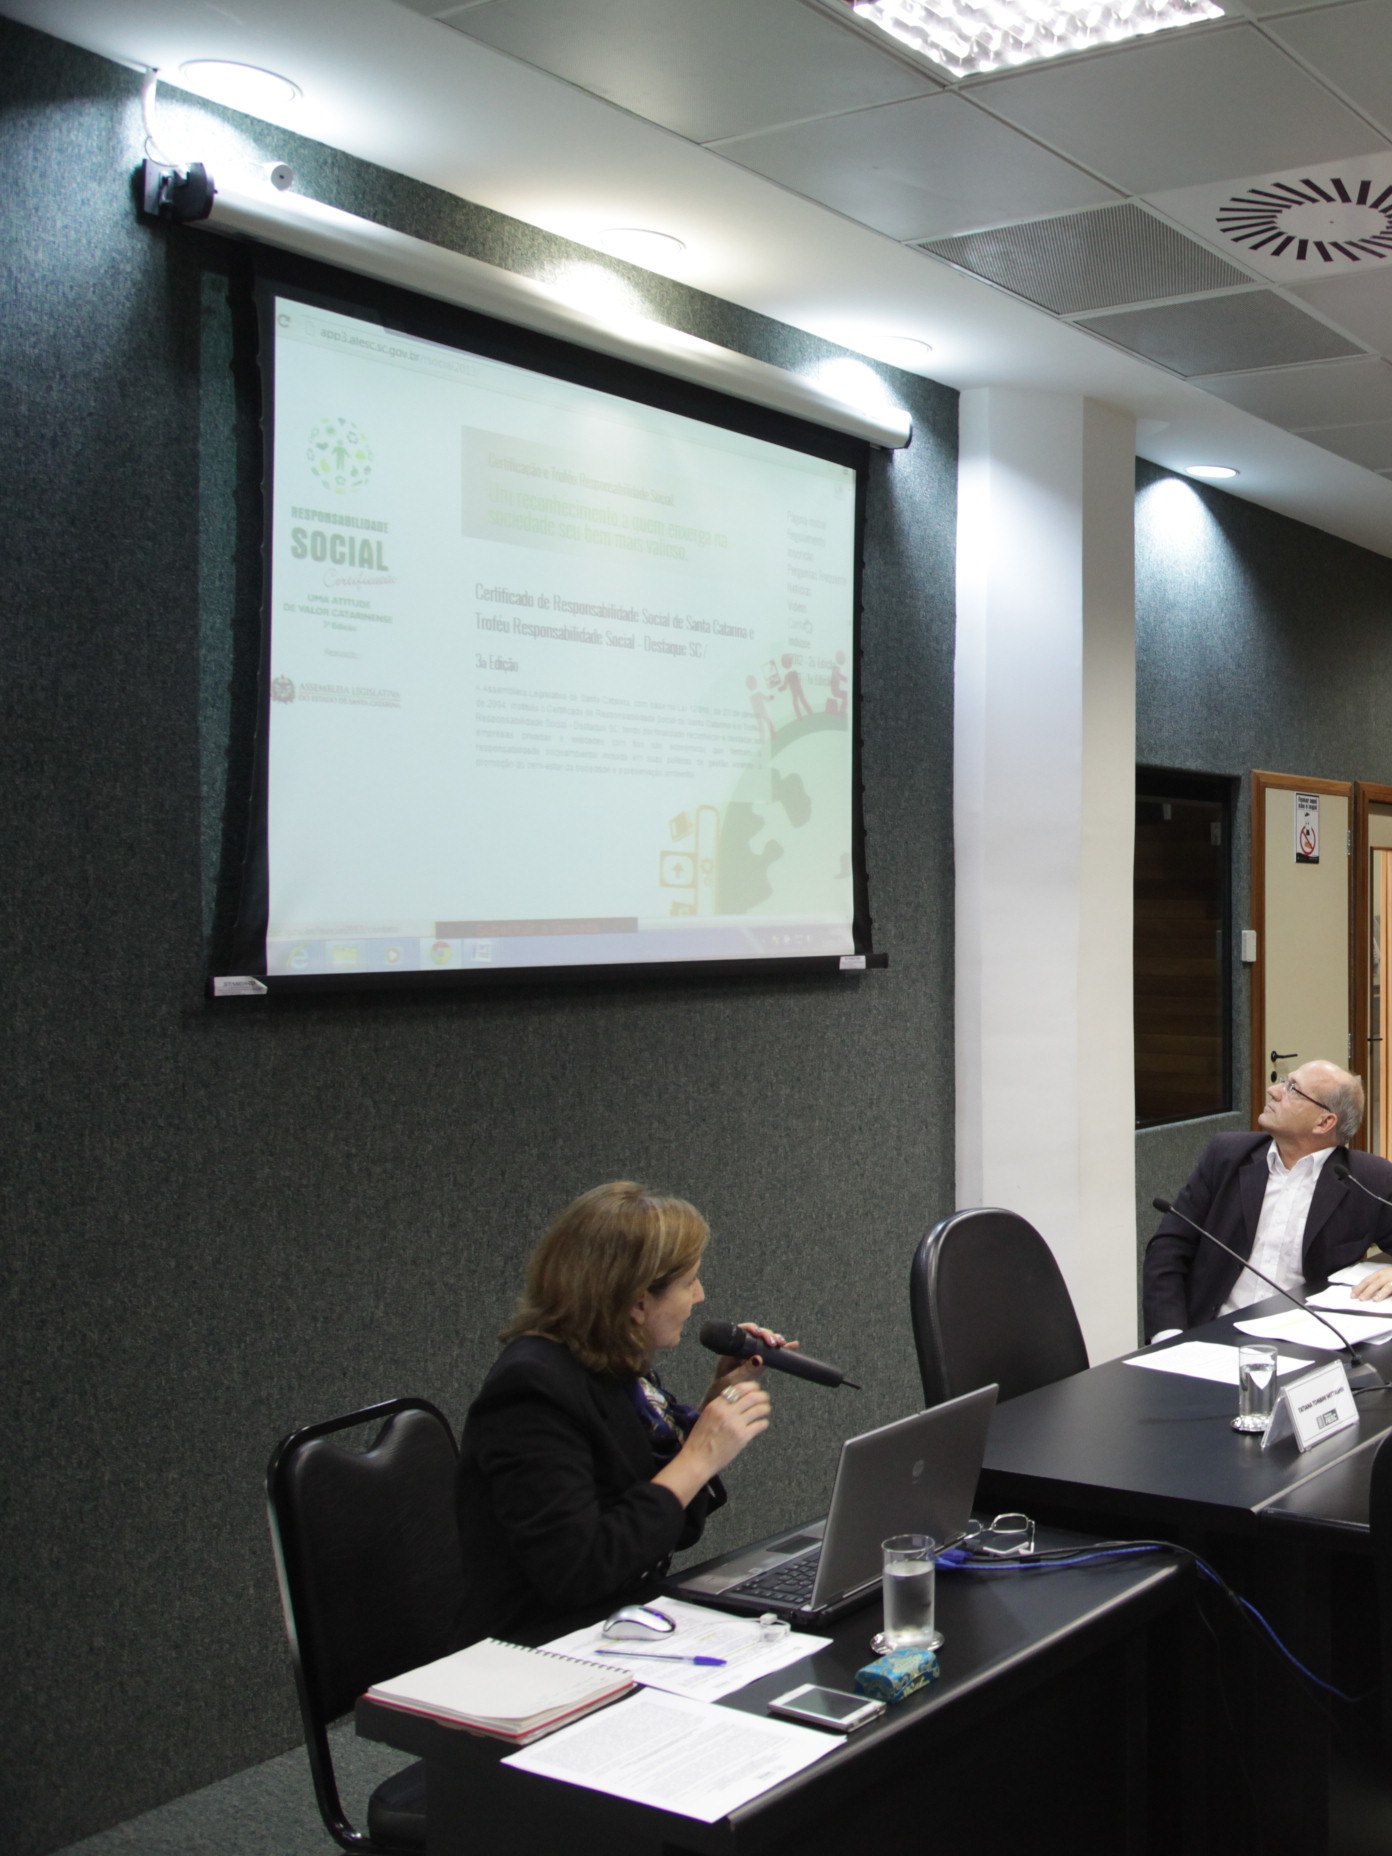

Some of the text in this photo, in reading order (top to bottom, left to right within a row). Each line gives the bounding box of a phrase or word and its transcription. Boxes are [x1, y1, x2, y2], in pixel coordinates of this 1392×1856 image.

[290, 505, 389, 534] RESPONSABILIDADE
[488, 509, 554, 537] sociedade
[559, 522, 581, 541] seu
[584, 522, 611, 547] bem
[614, 533, 643, 553] mais
[515, 492, 618, 528] reconhecimento
[622, 513, 628, 529] a
[632, 516, 665, 536] quem
[668, 523, 711, 549] enxerga
[714, 532, 728, 550] na
[290, 526, 389, 572] SOCIAL
[282, 602, 394, 625] DE VALOR CATARINENSE
[307, 593, 371, 610] UMA ATITUDE
[475, 582, 756, 641] Certificado de Responsabilidade Social de Santa Catarina e
[475, 611, 511, 634] Troféu
[513, 616, 603, 646] Responsabilidade
[605, 629, 636, 649] Social
[644, 635, 687, 658] Destaque
[475, 652, 520, 674] 3a Edição
